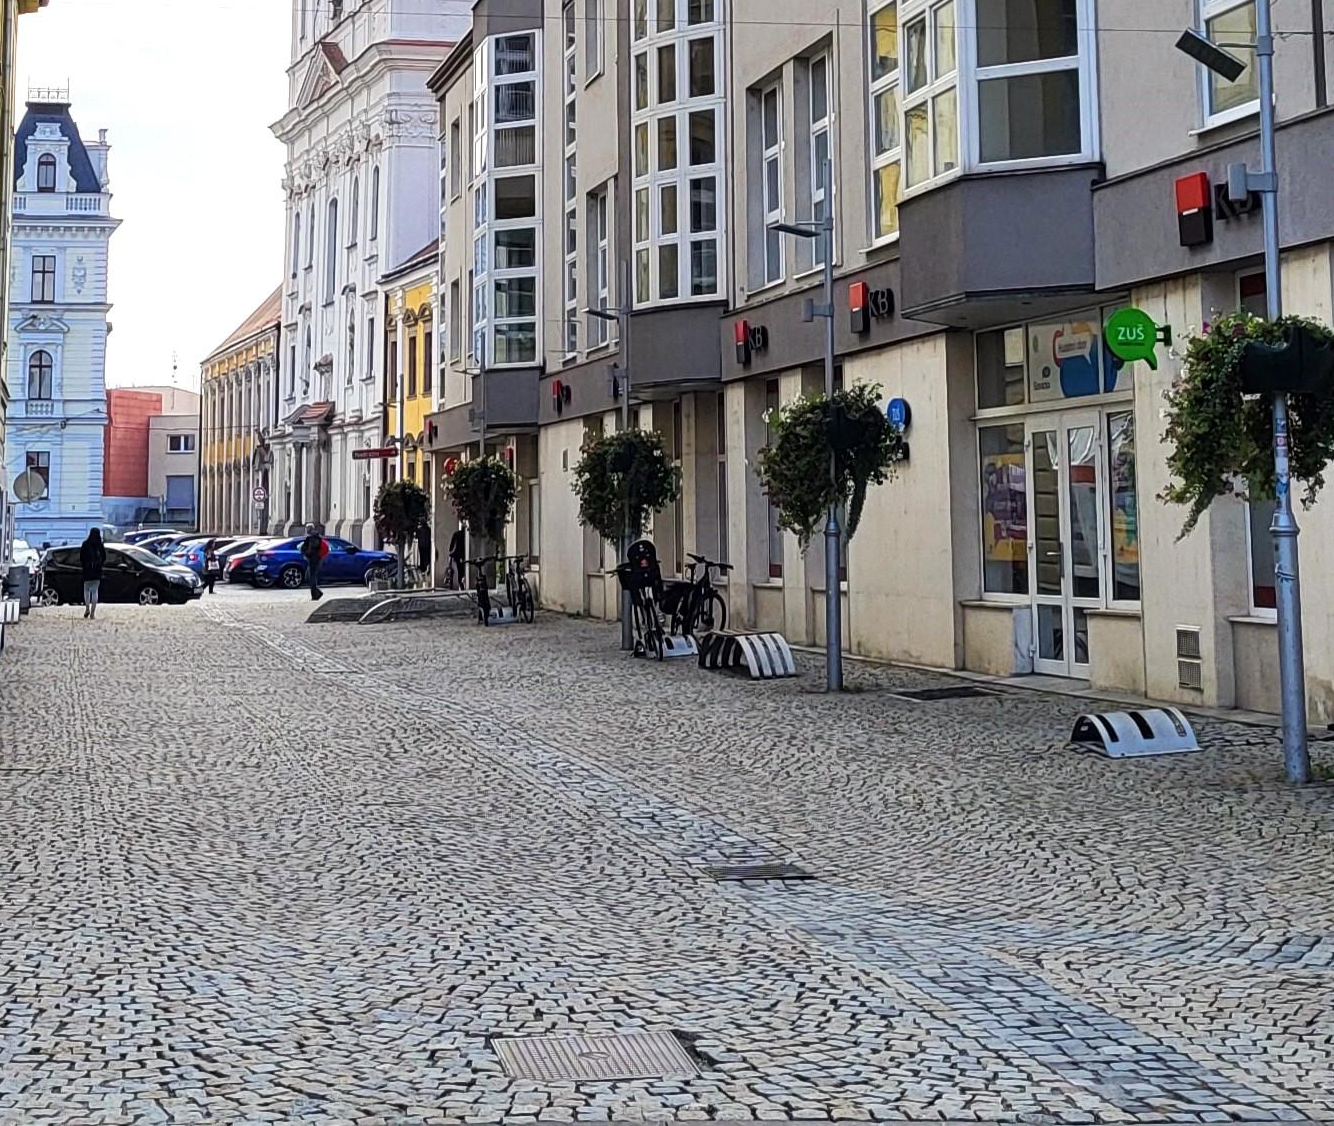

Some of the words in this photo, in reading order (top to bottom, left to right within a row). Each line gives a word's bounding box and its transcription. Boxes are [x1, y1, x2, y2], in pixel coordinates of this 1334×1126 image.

[868, 288, 895, 317] KB
[747, 325, 769, 350] KB
[1117, 324, 1145, 340] ZUŠ
